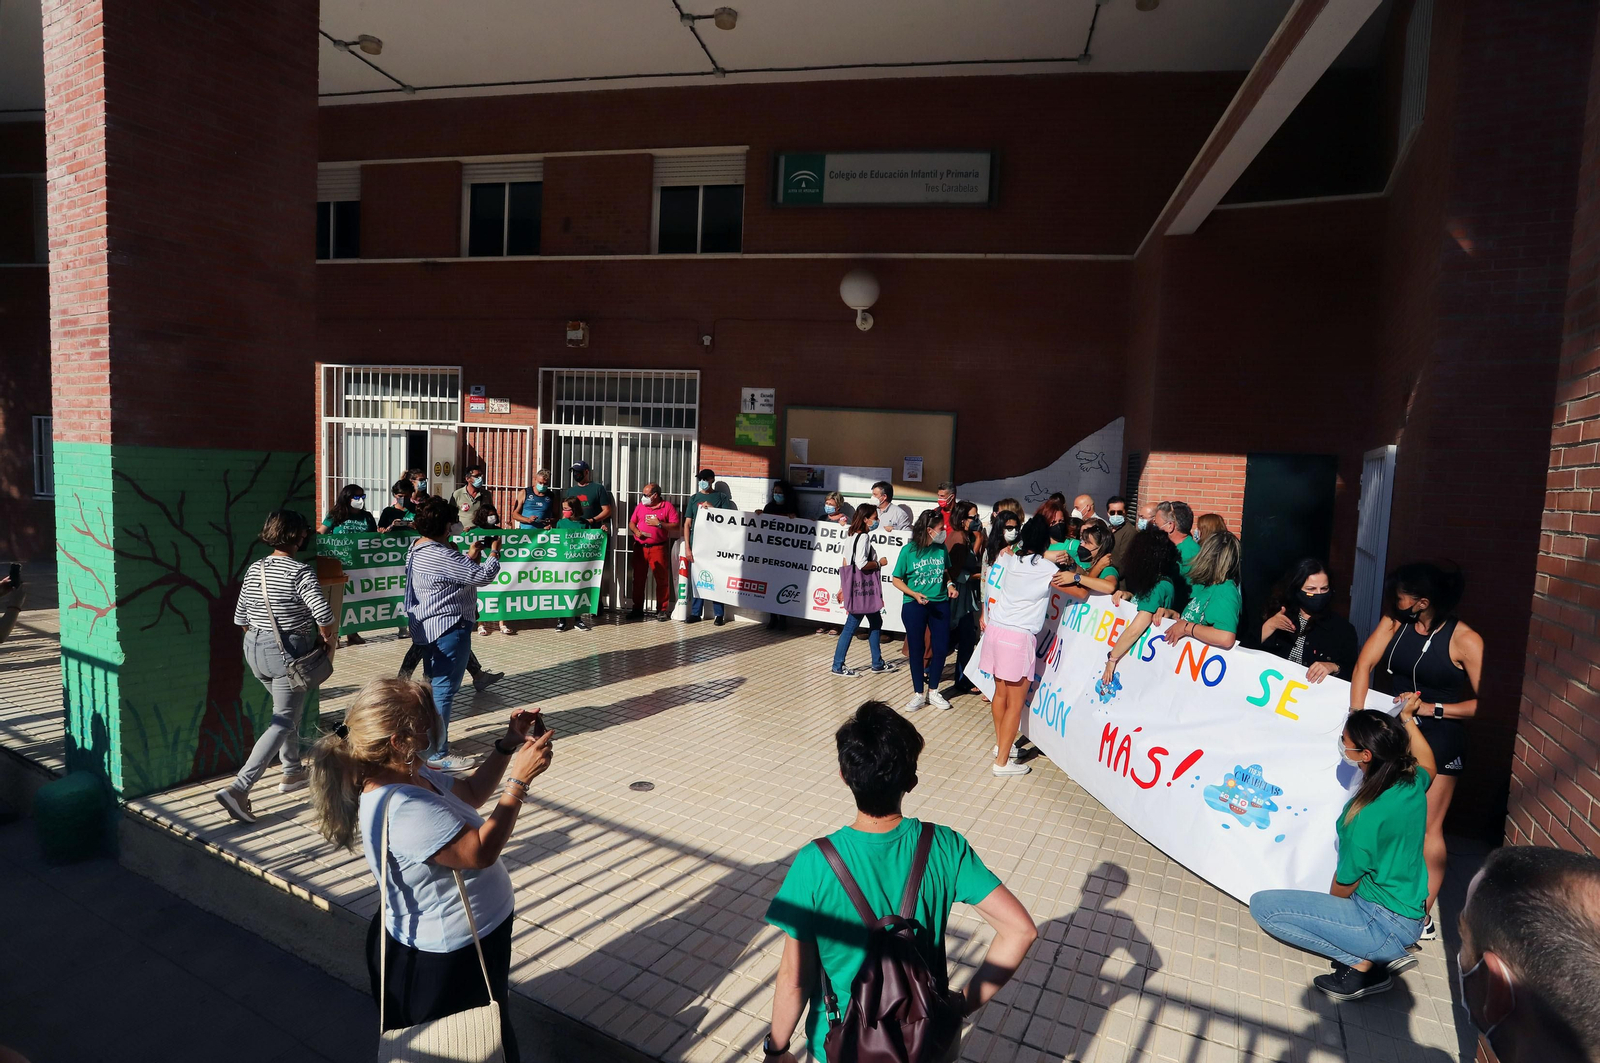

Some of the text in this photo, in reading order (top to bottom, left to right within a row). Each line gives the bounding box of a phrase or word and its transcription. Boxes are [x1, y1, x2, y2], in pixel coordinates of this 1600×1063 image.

[829, 169, 979, 181] Colegio de Educación Infantil y Primaria
[925, 183, 978, 193] Tres Carabelas
[706, 512, 724, 523] NO
[728, 516, 737, 525] A
[741, 517, 757, 528] LA
[760, 518, 817, 536] PÉRDIDA
[820, 528, 837, 539] DE
[537, 534, 560, 544] DE
[747, 532, 764, 544] LA
[766, 534, 822, 552] ESCUELA
[716, 550, 746, 561] JUNTA
[748, 555, 760, 564] DE
[762, 557, 809, 571] PERSONAL
[506, 593, 592, 612] HUELVA
[1175, 640, 1309, 720] NO SE
[1098, 722, 1204, 789] MÁS!
